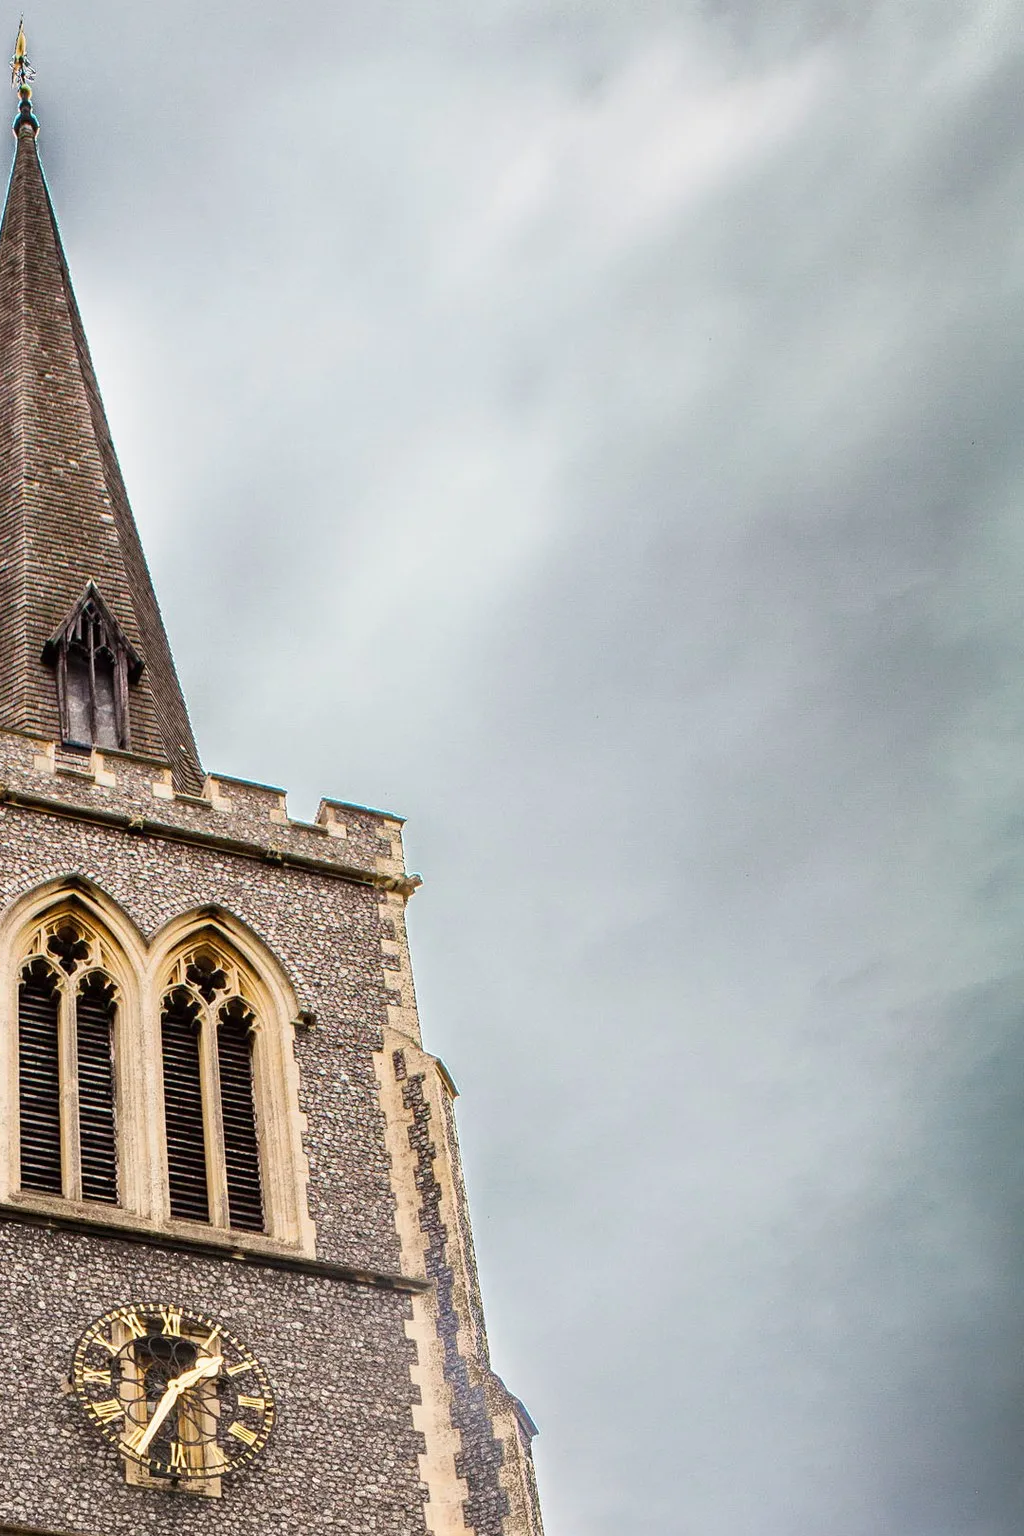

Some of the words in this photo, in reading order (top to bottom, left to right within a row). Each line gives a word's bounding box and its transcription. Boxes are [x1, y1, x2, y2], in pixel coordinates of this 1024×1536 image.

[120, 1313, 147, 1339] XI
[161, 1312, 181, 1337] XII
[92, 1333, 121, 1357] X
[201, 1330, 218, 1349] I
[83, 1366, 111, 1385] IX
[226, 1361, 252, 1377] II
[91, 1398, 125, 1425] VIII
[237, 1395, 265, 1410] III
[124, 1426, 148, 1451] II
[227, 1421, 258, 1446] IIII
[170, 1442, 187, 1468] VI
[207, 1442, 229, 1465] V
